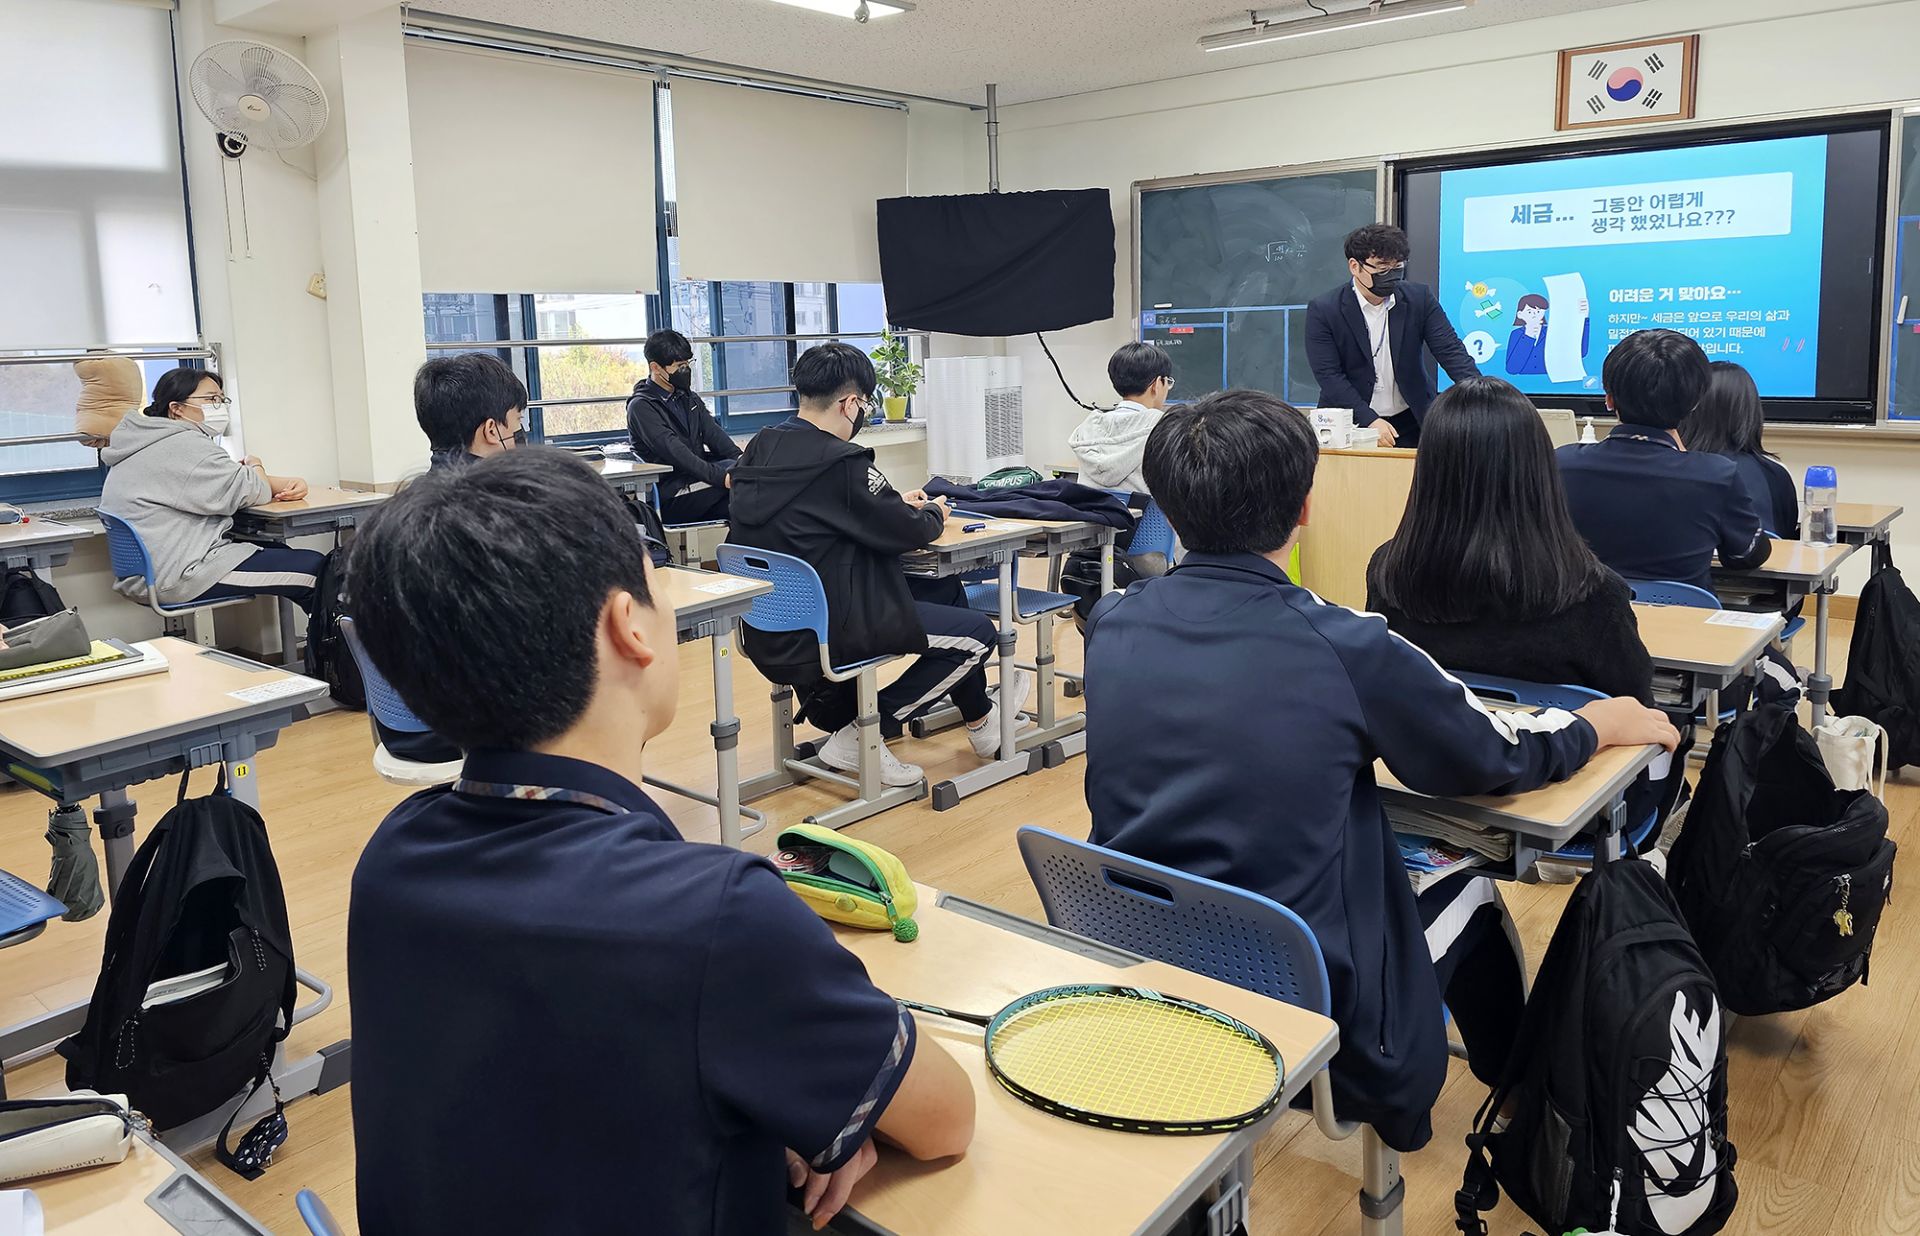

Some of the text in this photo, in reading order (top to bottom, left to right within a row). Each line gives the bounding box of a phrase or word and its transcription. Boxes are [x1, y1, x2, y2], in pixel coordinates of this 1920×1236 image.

[1591, 191, 1704, 215] 그동안 어렵게
[1510, 202, 1575, 225] 세금...
[1591, 209, 1736, 234] 생각 했었나요???
[1609, 288, 1655, 303] 어려운
[1658, 287, 1674, 302] 거
[1608, 310, 1790, 324] 하지만~ 세금은 앞으로 우리의 삶과
[1702, 327, 1726, 338] 있기
[1729, 326, 1766, 338] 때문에
[1473, 339, 1484, 355] ?
[984, 476, 1025, 488] CAMPUS
[236, 766, 246, 776] 11
[1626, 990, 1716, 1188] NIKE
